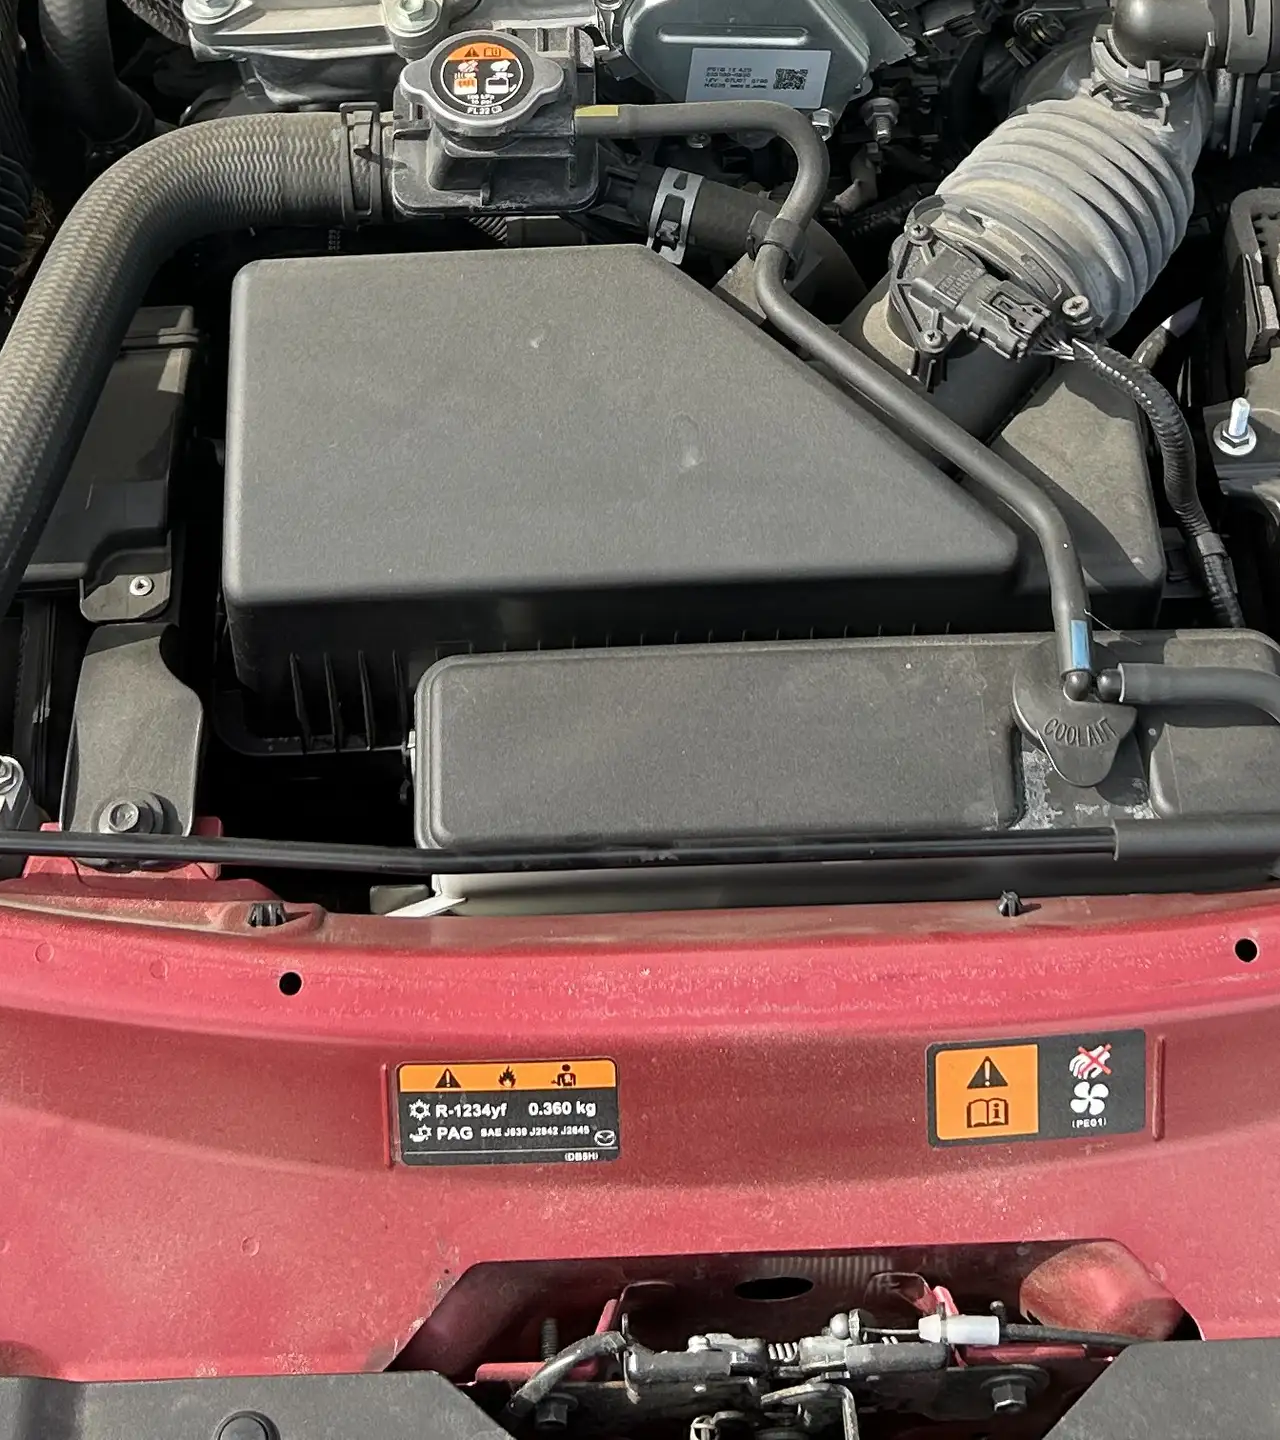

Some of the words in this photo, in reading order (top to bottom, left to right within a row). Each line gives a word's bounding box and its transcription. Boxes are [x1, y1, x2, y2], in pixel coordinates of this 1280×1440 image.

[1043, 716, 1118, 747] COOLANT
[435, 1102, 507, 1120] R-1234yf
[528, 1101, 572, 1116] 0.360
[576, 1100, 596, 1118] kg
[437, 1126, 473, 1140] PAG
